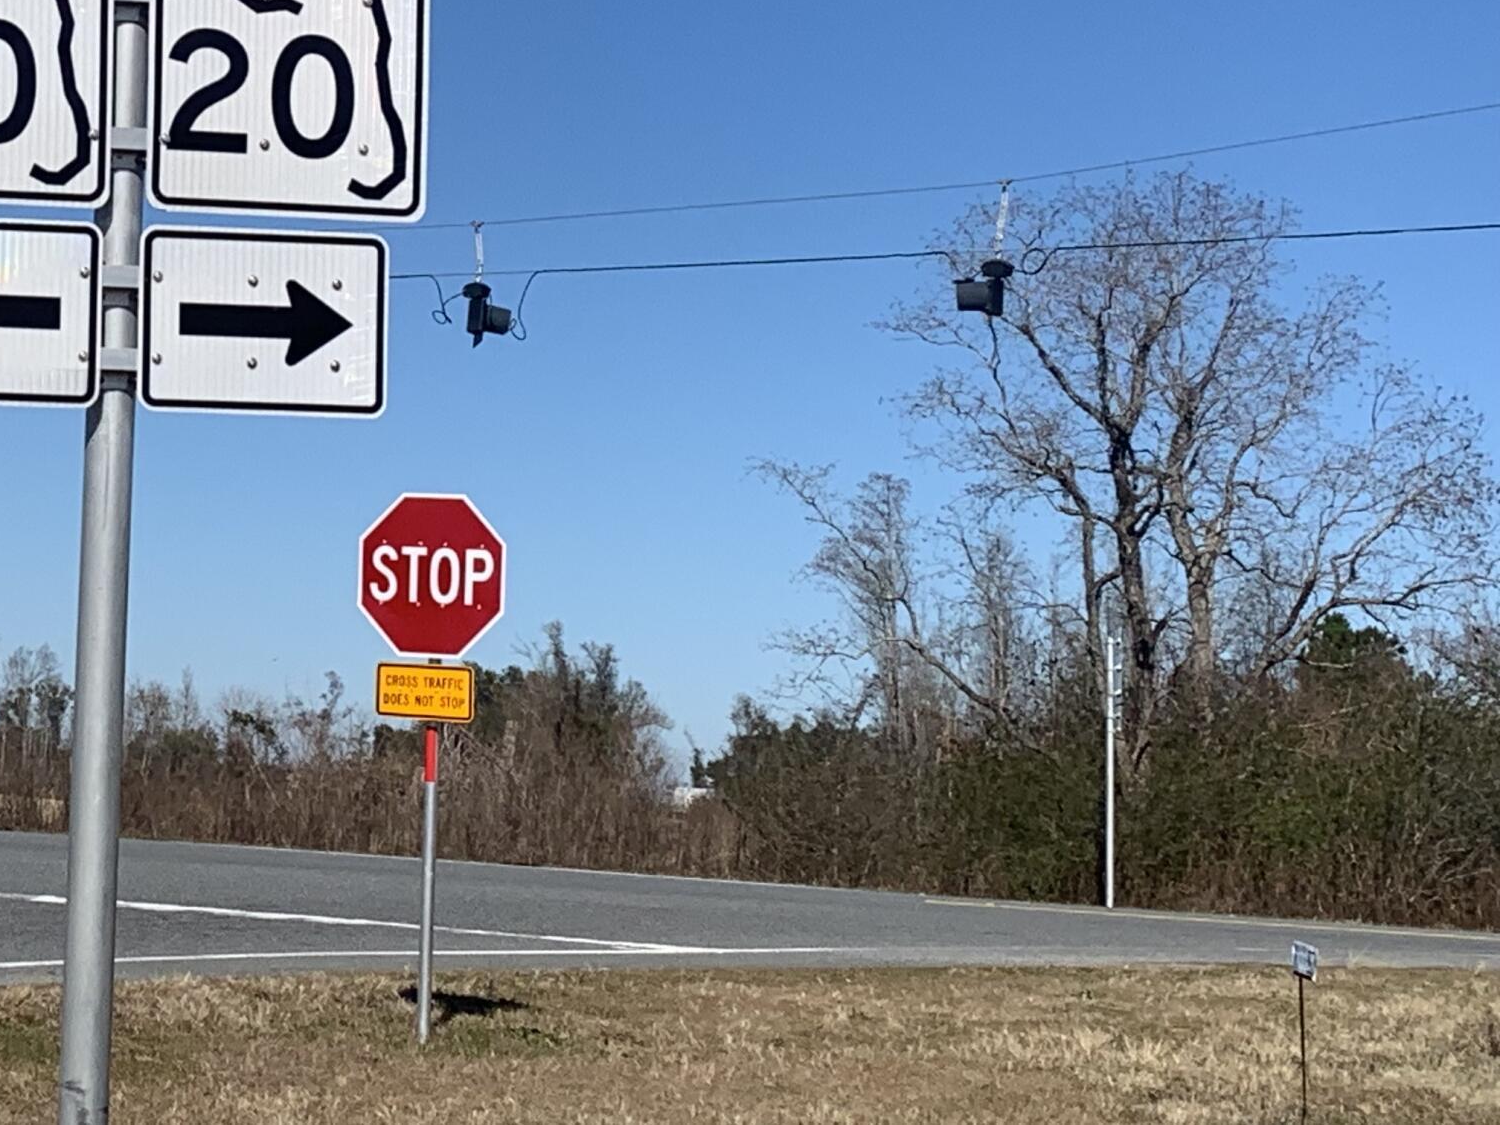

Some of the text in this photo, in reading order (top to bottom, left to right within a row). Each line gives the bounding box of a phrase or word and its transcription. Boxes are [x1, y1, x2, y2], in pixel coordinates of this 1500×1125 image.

[166, 27, 356, 160] 20
[369, 545, 494, 606] STOP
[383, 692, 466, 709] DOES NOT STOP
[385, 675, 464, 691] CROSS TRAFFIC
